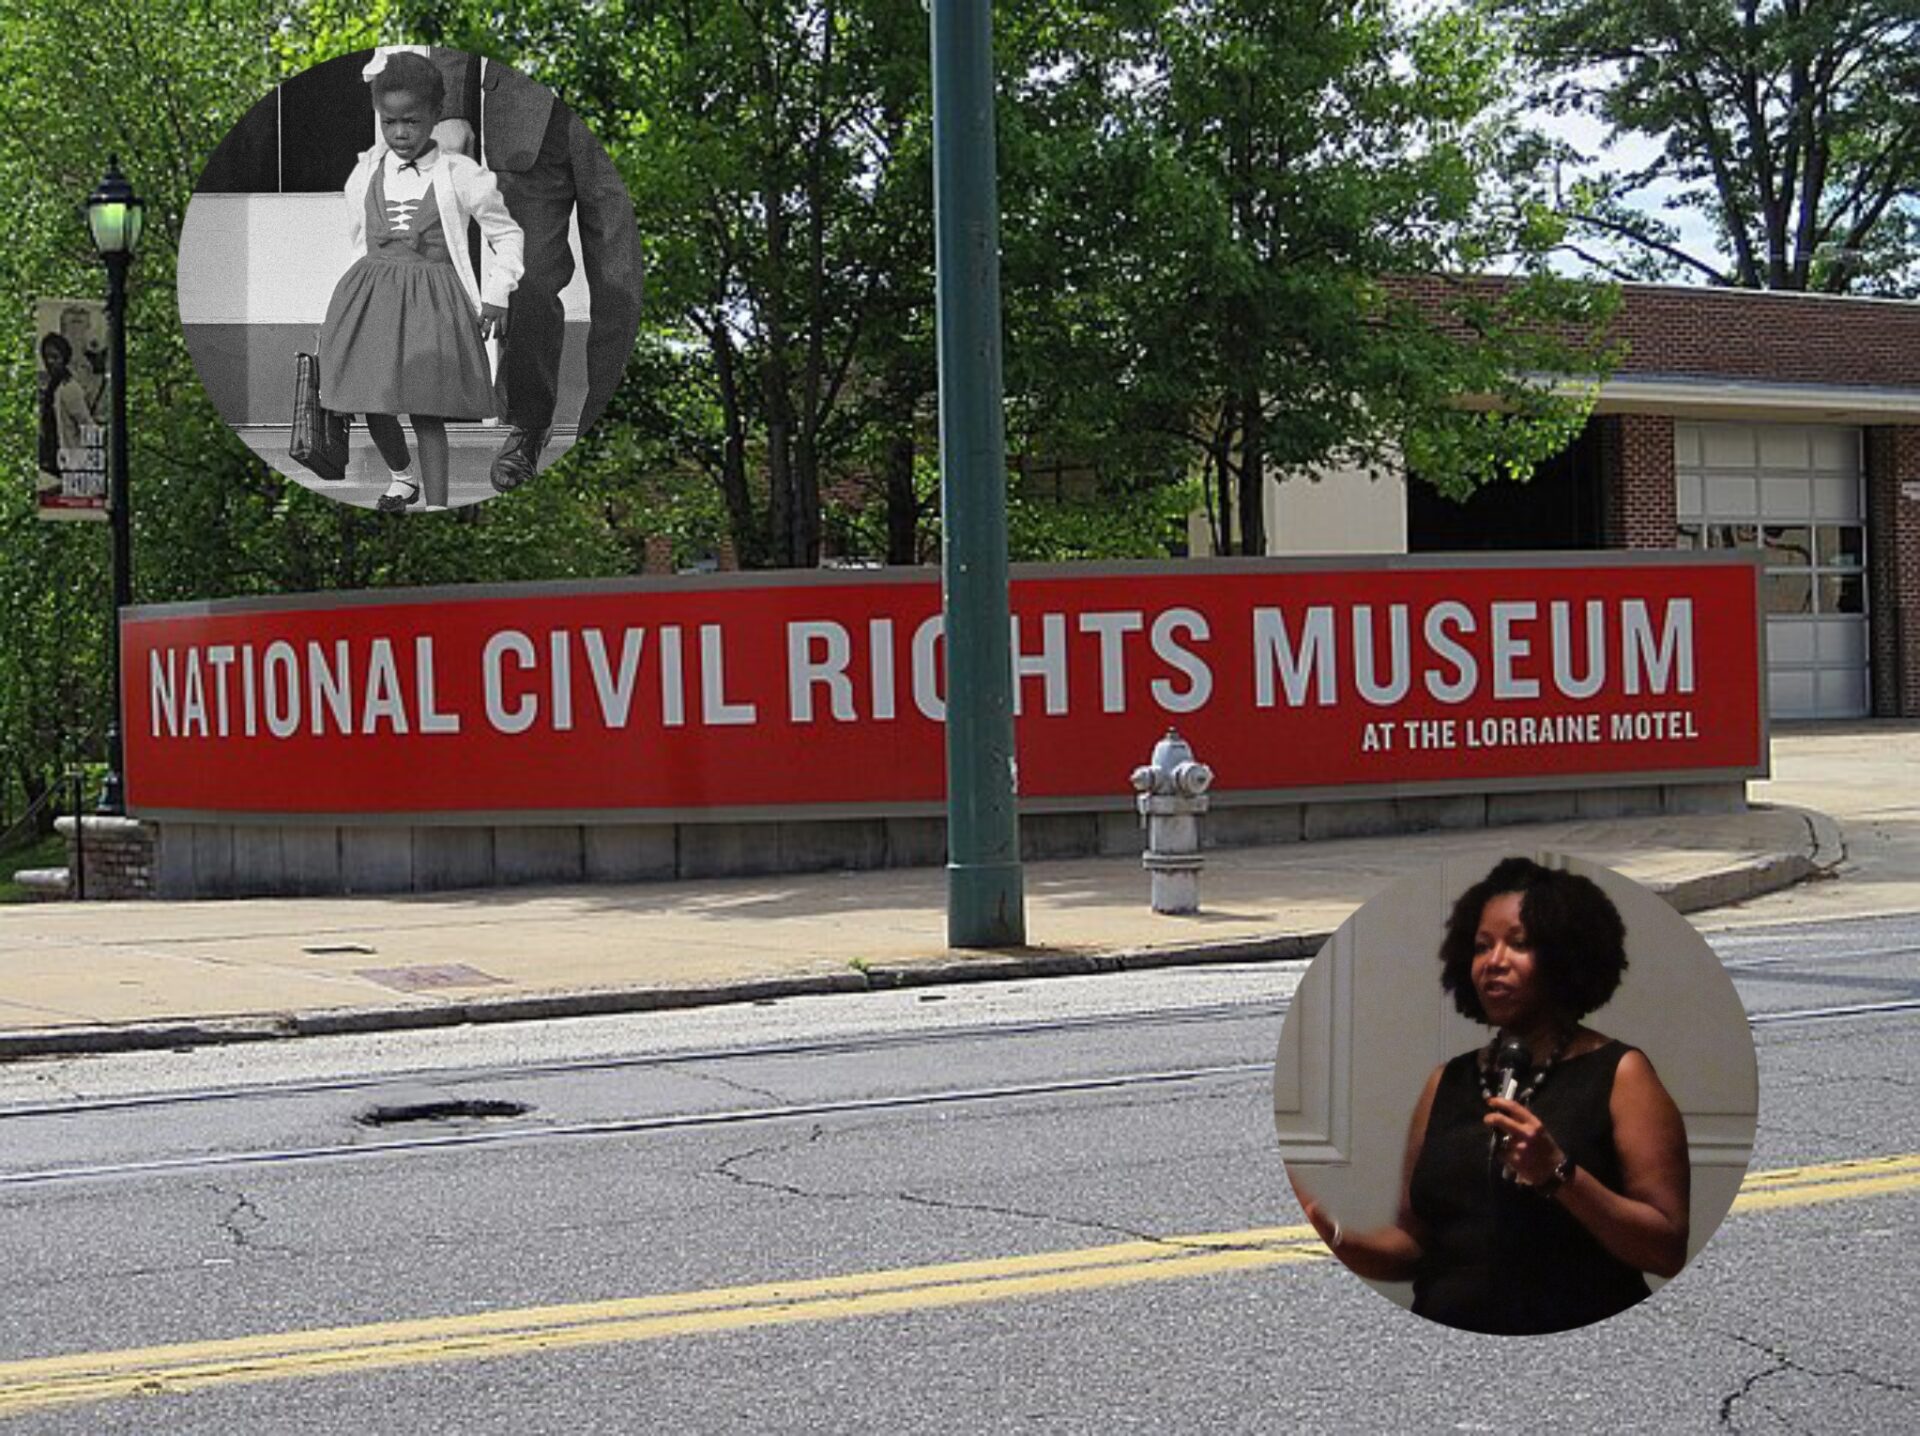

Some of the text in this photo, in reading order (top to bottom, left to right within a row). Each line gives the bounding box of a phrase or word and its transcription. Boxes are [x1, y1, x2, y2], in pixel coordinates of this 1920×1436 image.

[149, 635, 461, 738] NATIONAL
[482, 624, 757, 734] CIVIL
[1252, 597, 1695, 708] MUSEUM
[1362, 710, 1700, 752] AT THE LORRAINE MOTEL
